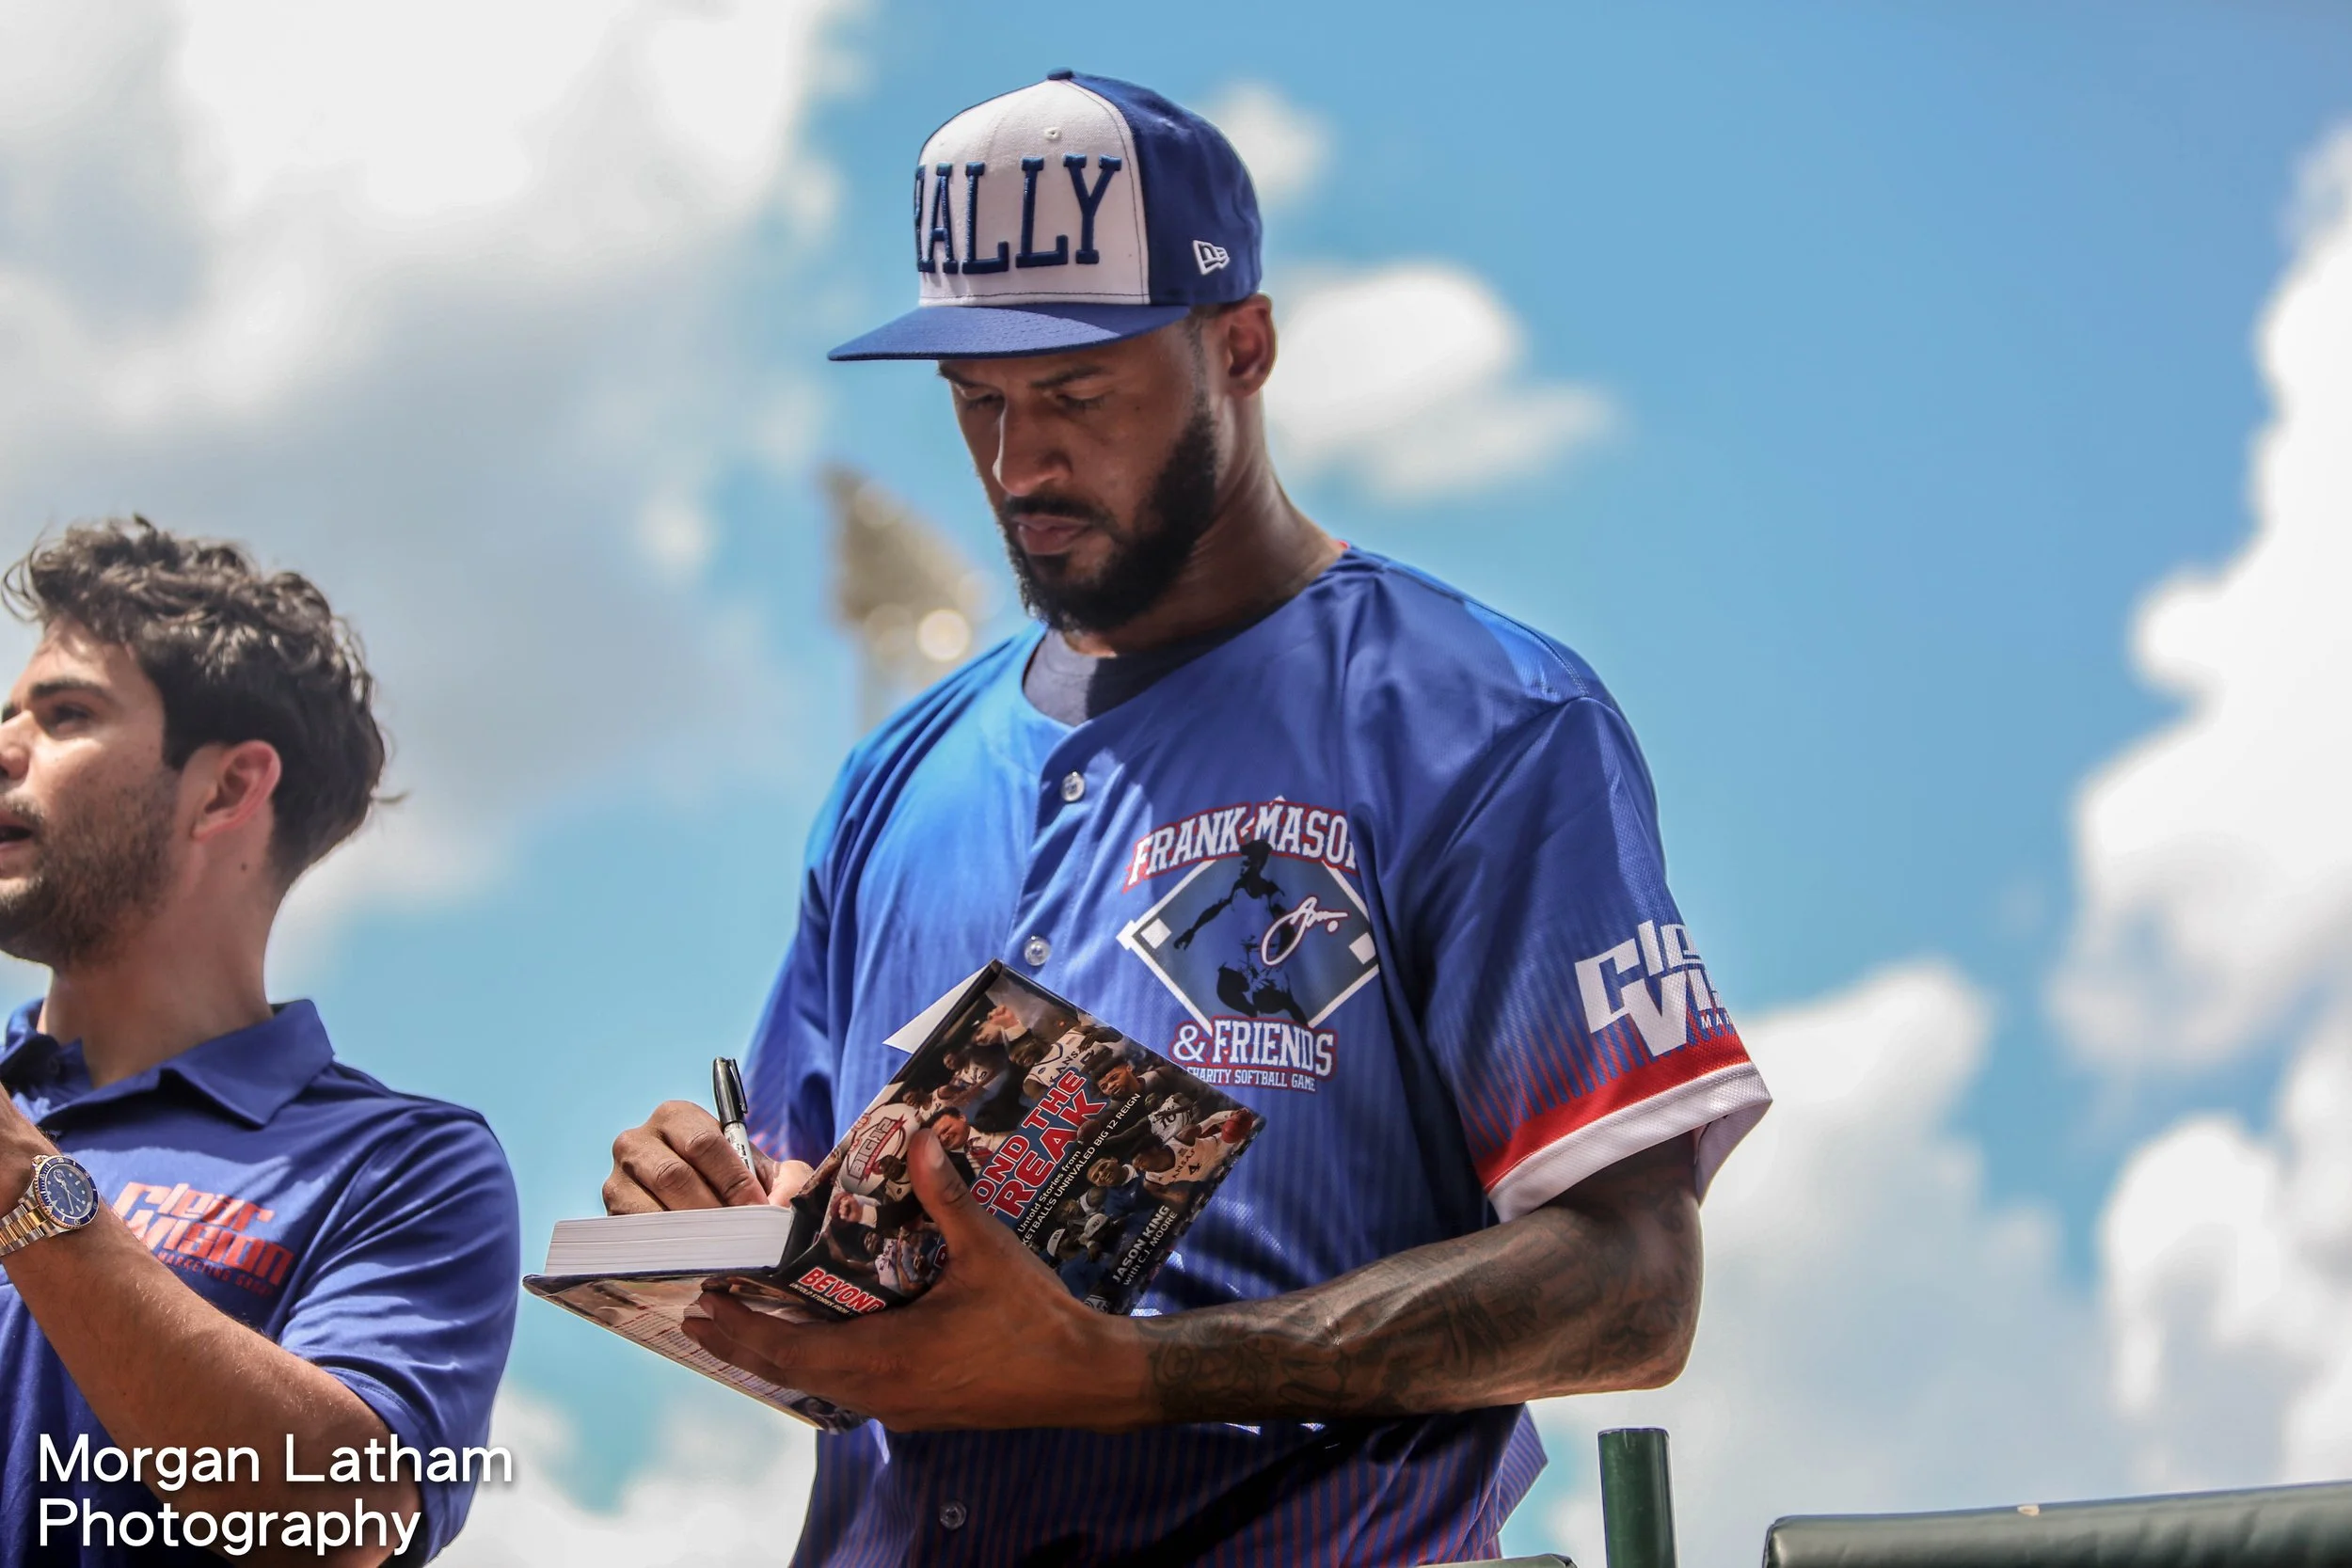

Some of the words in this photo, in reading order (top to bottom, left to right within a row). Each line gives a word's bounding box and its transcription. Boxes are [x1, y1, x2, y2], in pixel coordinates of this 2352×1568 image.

[1127, 806, 1248, 886] FRANK
[1172, 1024, 1205, 1063] &
[1212, 1020, 1334, 1077] FRIENDS
[1234, 1068, 1288, 1088] SOFTBALL
[1291, 1072, 1316, 1092] GAME
[971, 1134, 1031, 1206] OND
[1021, 1069, 1088, 1131] THE
[986, 1089, 1107, 1219] REAK
[1022, 1197, 1057, 1246] KETBALL'S
[1056, 1146, 1096, 1199] UNRIVALED
[1093, 1130, 1109, 1147] BIG
[1106, 1119, 1119, 1132] 12
[1115, 1093, 1141, 1121] REIGN
[1017, 1202, 1041, 1233] Untold
[1038, 1172, 1064, 1204] Stories
[1060, 1149, 1082, 1174] from
[1112, 1238, 1146, 1283] JASON
[1142, 1205, 1170, 1238] KING
[1123, 1265, 1140, 1286] with
[1151, 1211, 1178, 1247] MOORE
[798, 1266, 886, 1315] BEYOND
